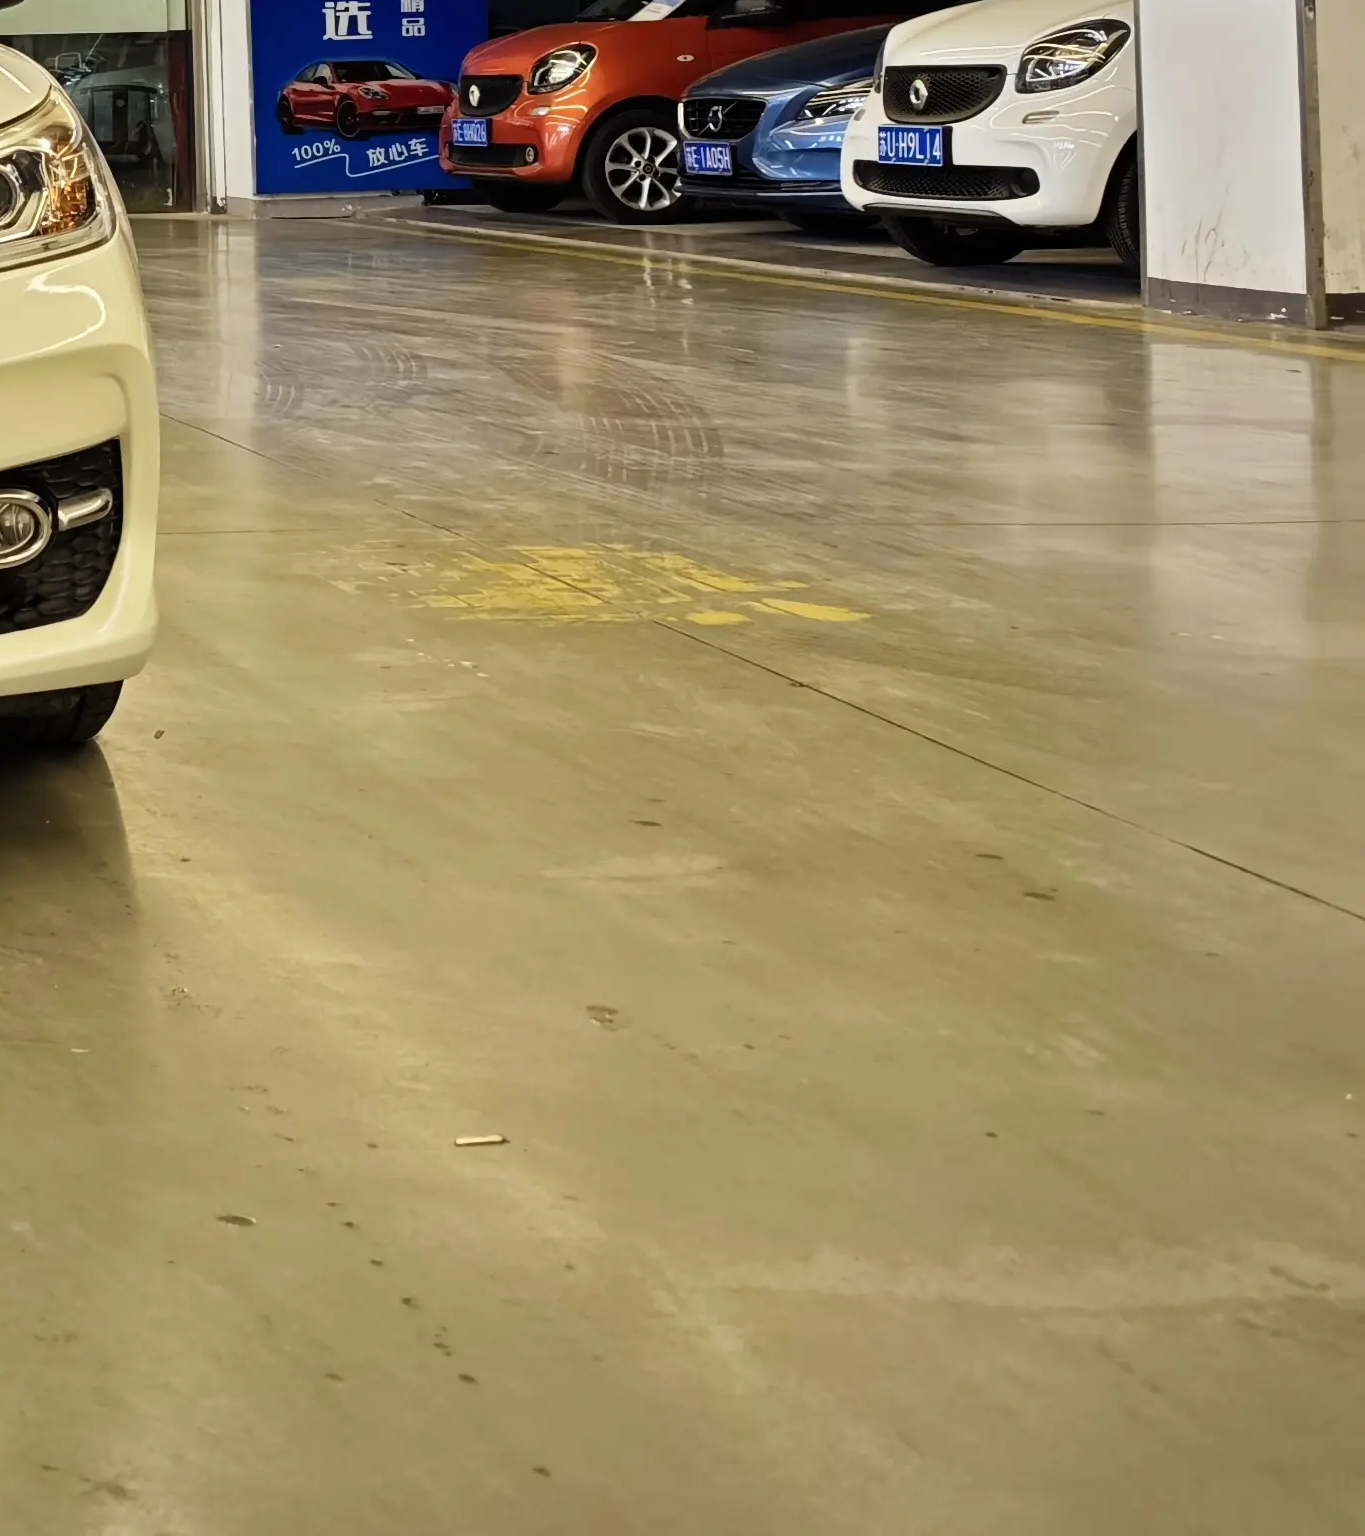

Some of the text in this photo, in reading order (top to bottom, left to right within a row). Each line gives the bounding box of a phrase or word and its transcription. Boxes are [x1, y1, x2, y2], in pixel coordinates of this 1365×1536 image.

[291, 137, 429, 168] 100% 放心车
